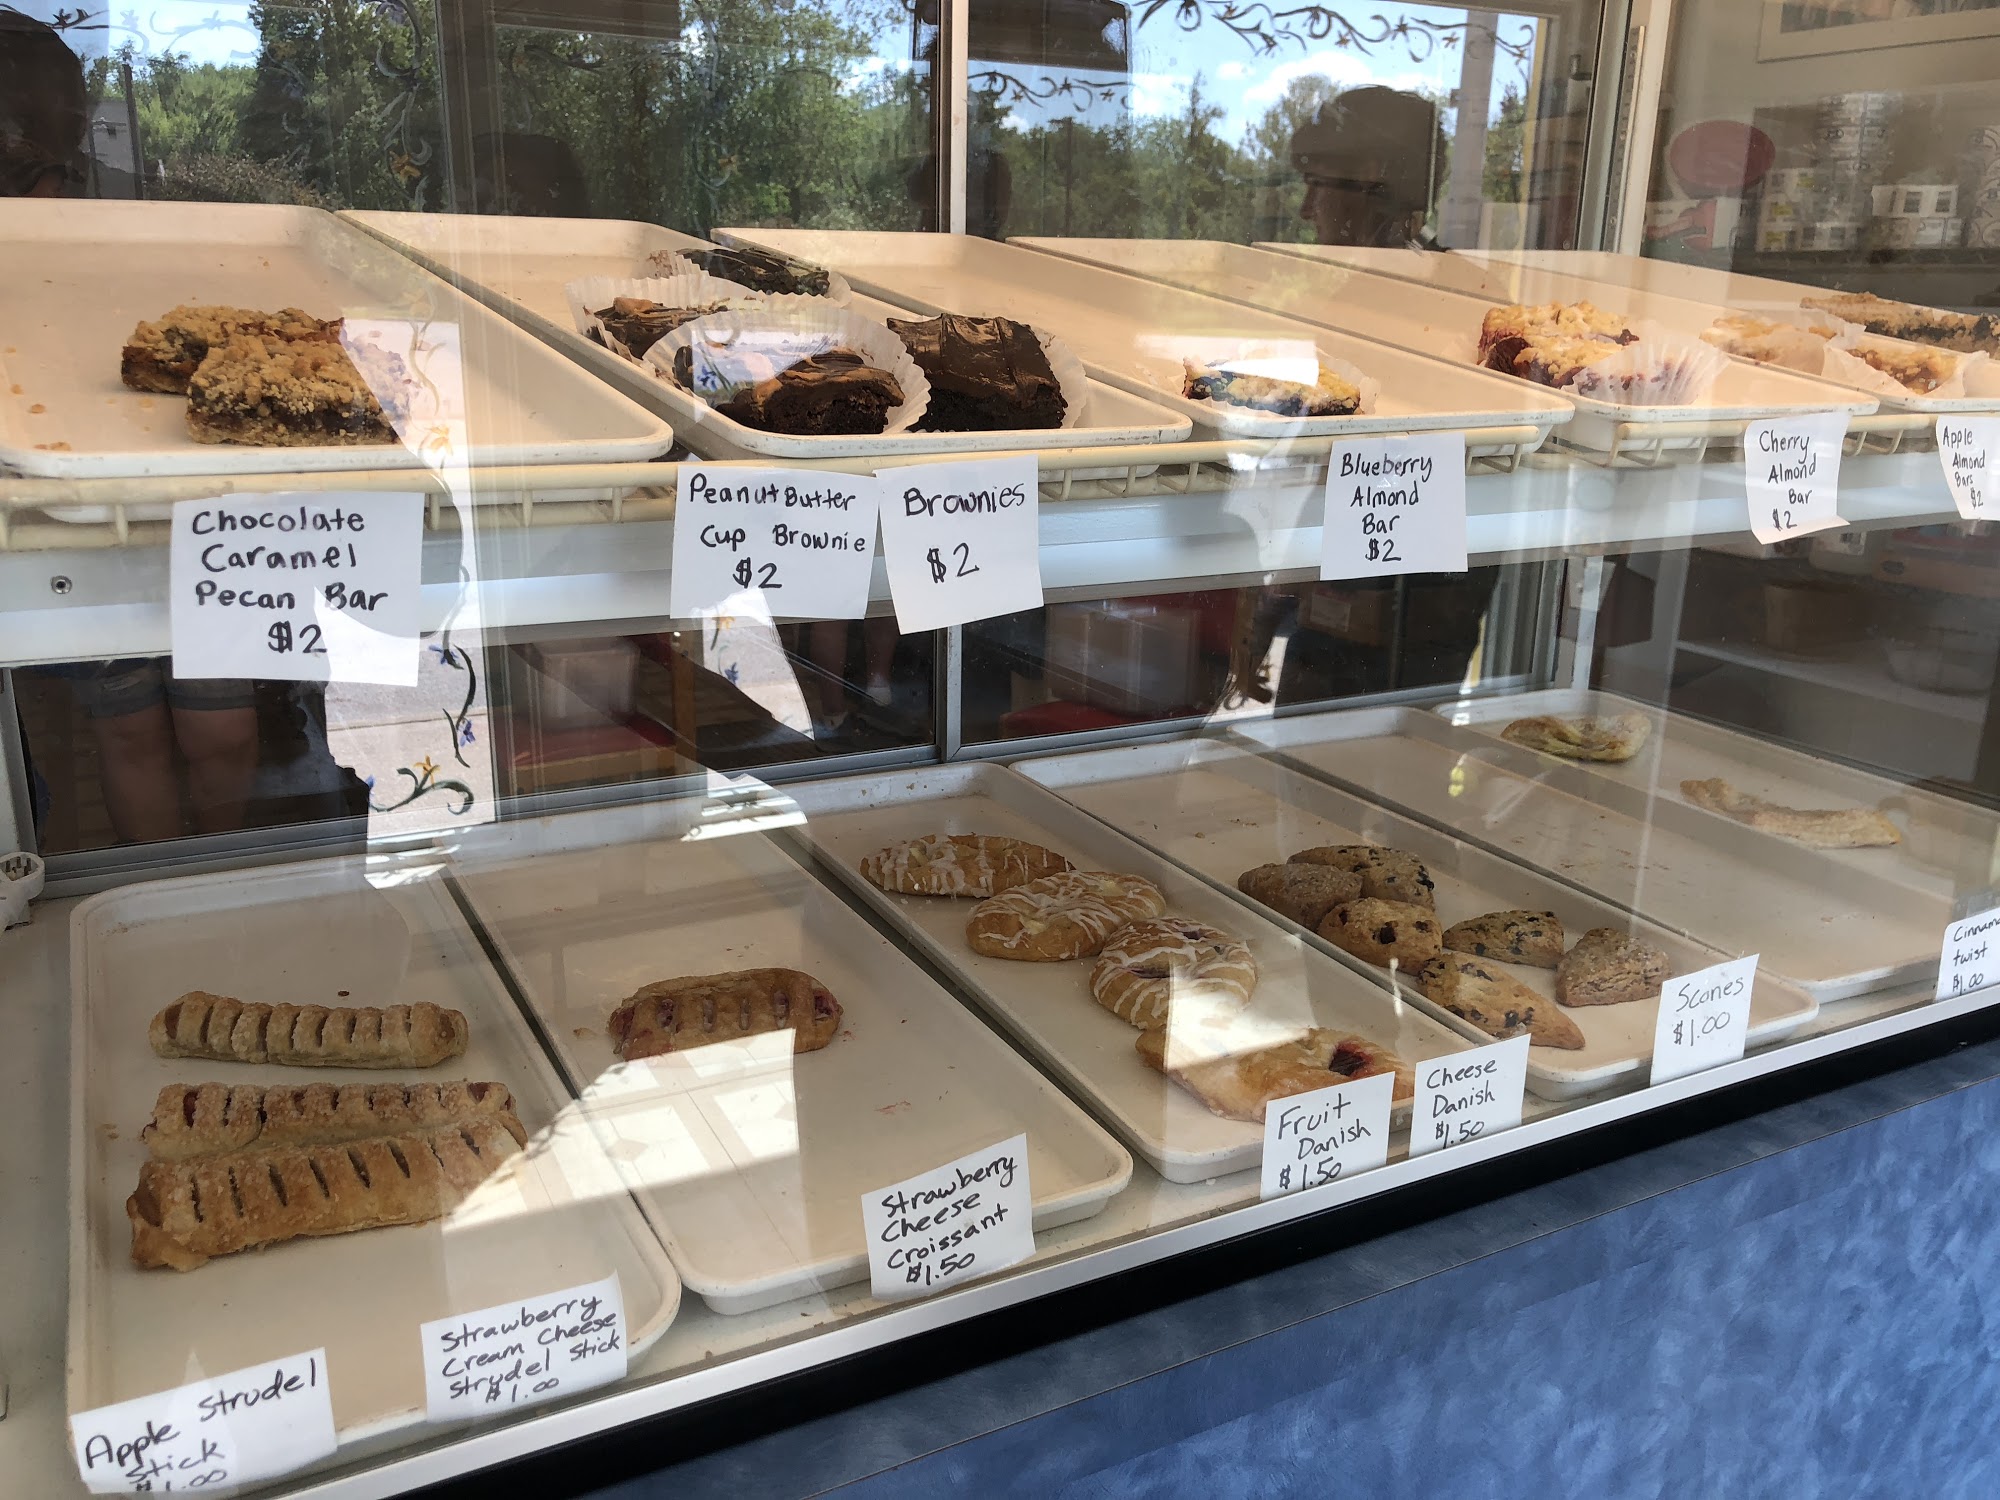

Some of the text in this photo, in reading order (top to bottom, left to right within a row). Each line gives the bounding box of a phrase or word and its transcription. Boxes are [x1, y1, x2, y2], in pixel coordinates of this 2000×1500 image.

[1759, 430, 1809, 464] Cherry
[1943, 425, 1973, 448] Apple
[1340, 452, 1433, 483] Blueberry
[1768, 453, 1817, 484] Almond
[1952, 449, 1985, 469] Almond
[690, 472, 856, 511] Peanut Butter
[1350, 480, 1419, 508] Almond
[1954, 471, 1973, 487] Bars
[903, 483, 1025, 517] Brownies
[1789, 488, 1812, 504] Bar
[1970, 487, 1984, 509] $2
[192, 507, 365, 534] Chocolate
[1361, 512, 1400, 535] Bar
[1772, 508, 1797, 531] $2
[700, 524, 866, 552] Cup Brownie
[1365, 538, 1401, 562] $2
[201, 543, 357, 572] Caramel
[732, 557, 782, 589] $2
[927, 542, 980, 583] $2
[195, 580, 389, 611] Pecan Bar
[268, 620, 327, 653] $2
[1953, 941, 1988, 966] twist
[1676, 977, 1744, 1012] Scones
[1673, 1011, 1730, 1046] $1.00
[1427, 1059, 1497, 1089] Cheese
[1432, 1080, 1495, 1118] Danish
[1278, 1093, 1351, 1140] Fruit
[1297, 1119, 1371, 1161] Danish
[1435, 1120, 1484, 1149] $1.50
[881, 1192, 980, 1242] Cheese
[887, 1203, 1008, 1269] Croissant
[906, 1252, 975, 1286] $1.50
[442, 1312, 616, 1377] Cream Cheese
[85, 1421, 180, 1469] Apple
